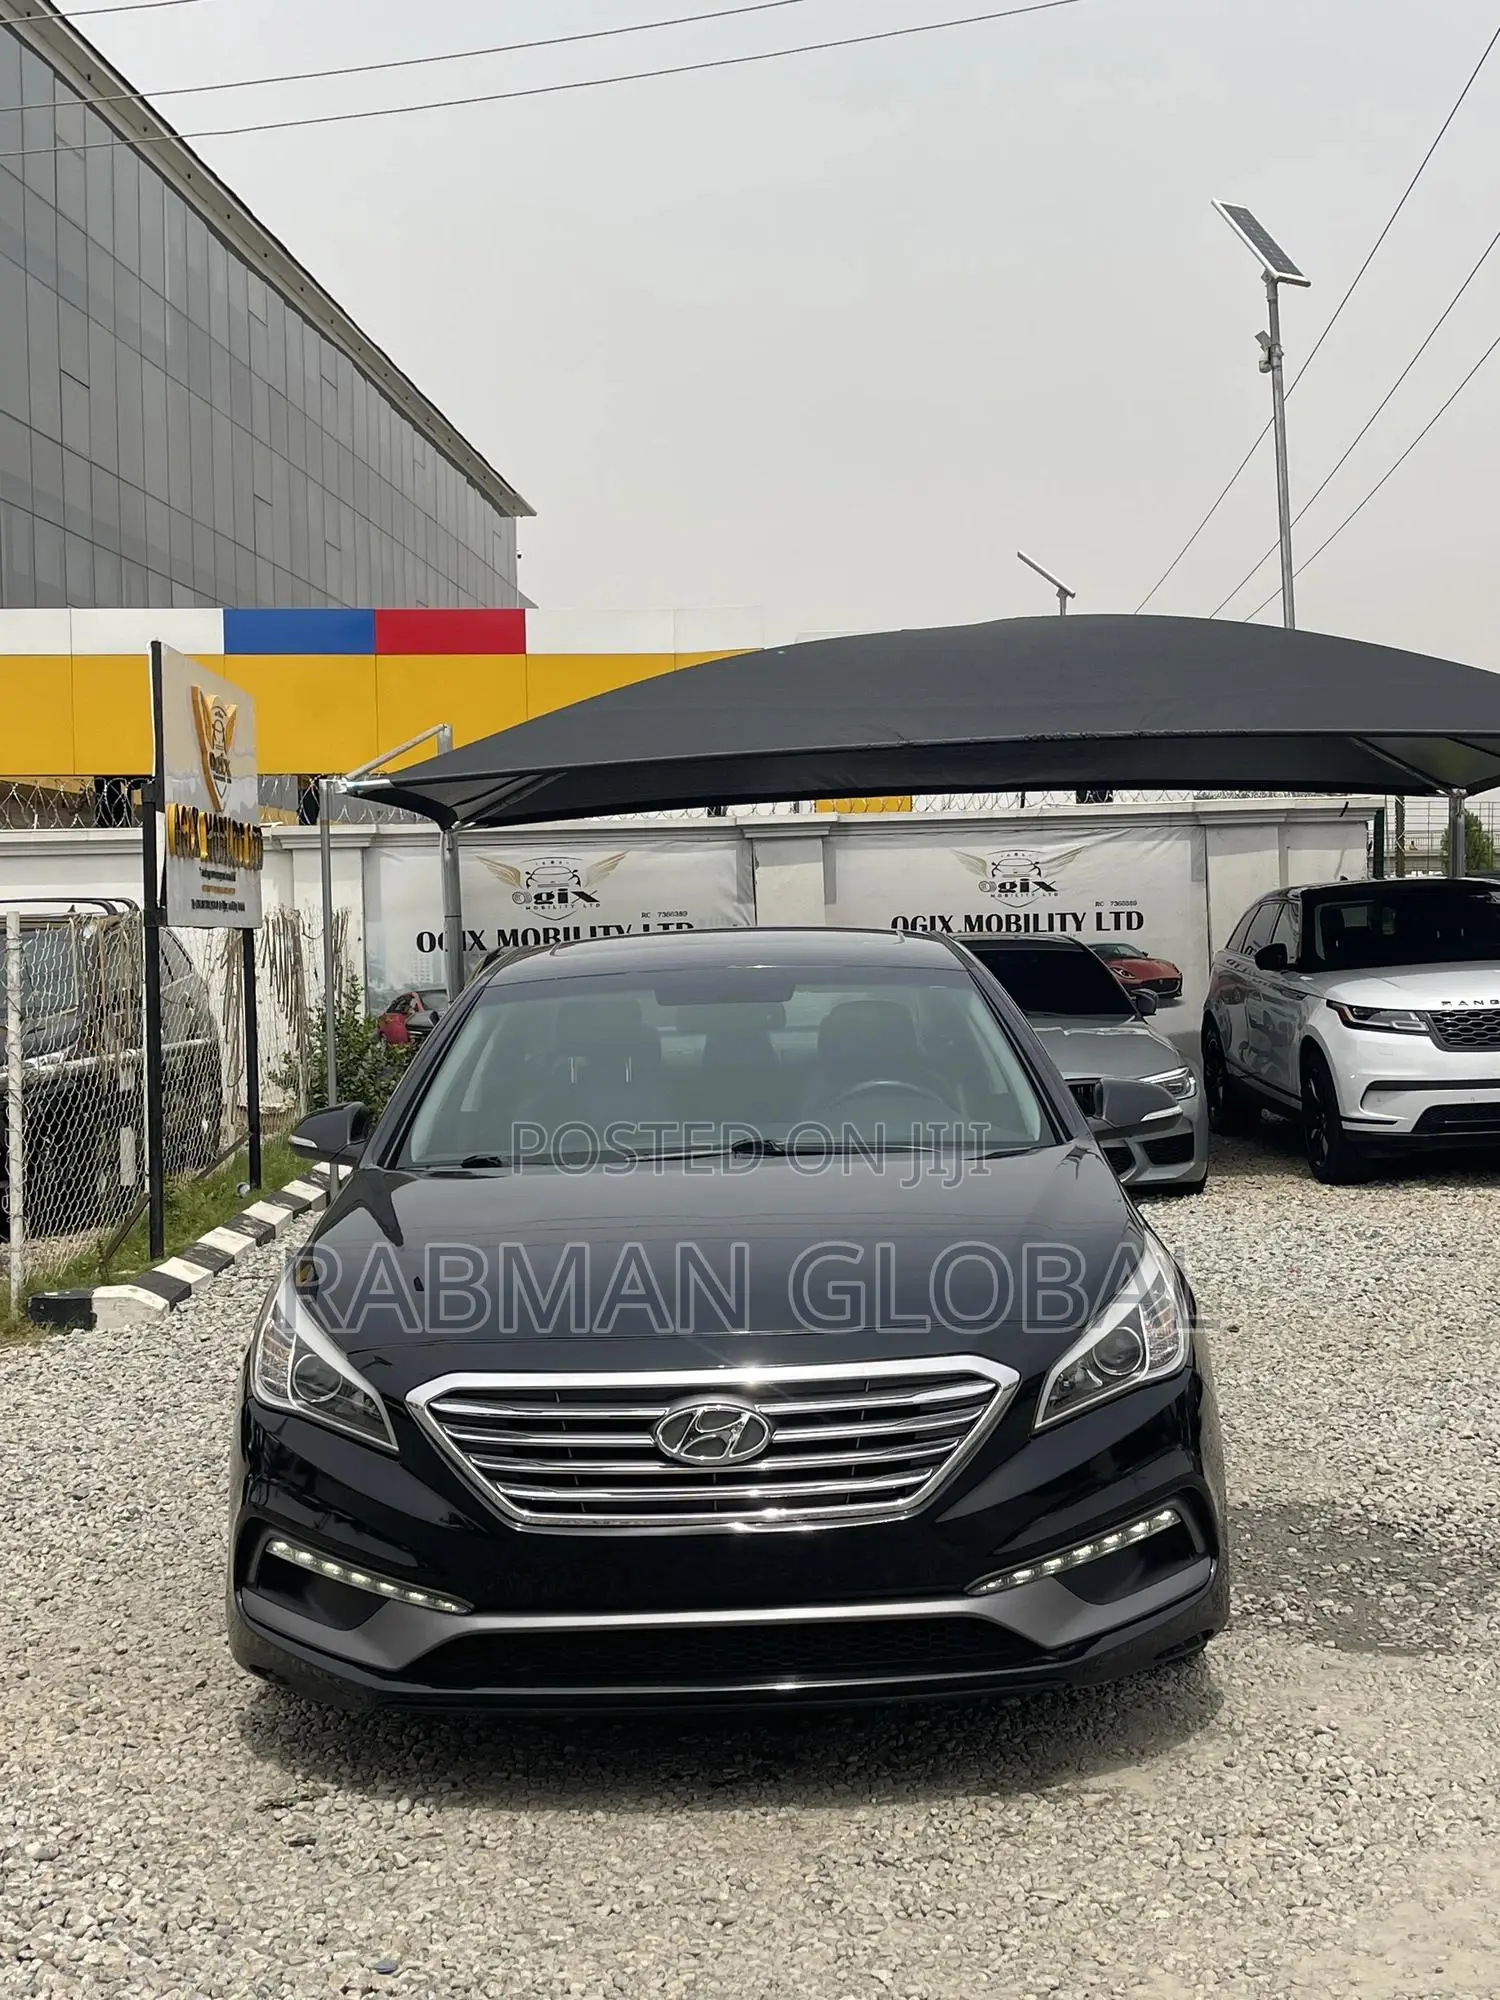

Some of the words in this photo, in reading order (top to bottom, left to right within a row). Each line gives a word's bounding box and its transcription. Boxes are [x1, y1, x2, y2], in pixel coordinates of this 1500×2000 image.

[891, 915, 954, 933] OGIX
[964, 912, 1087, 933] MOBILITY
[1095, 911, 1144, 931] LTD
